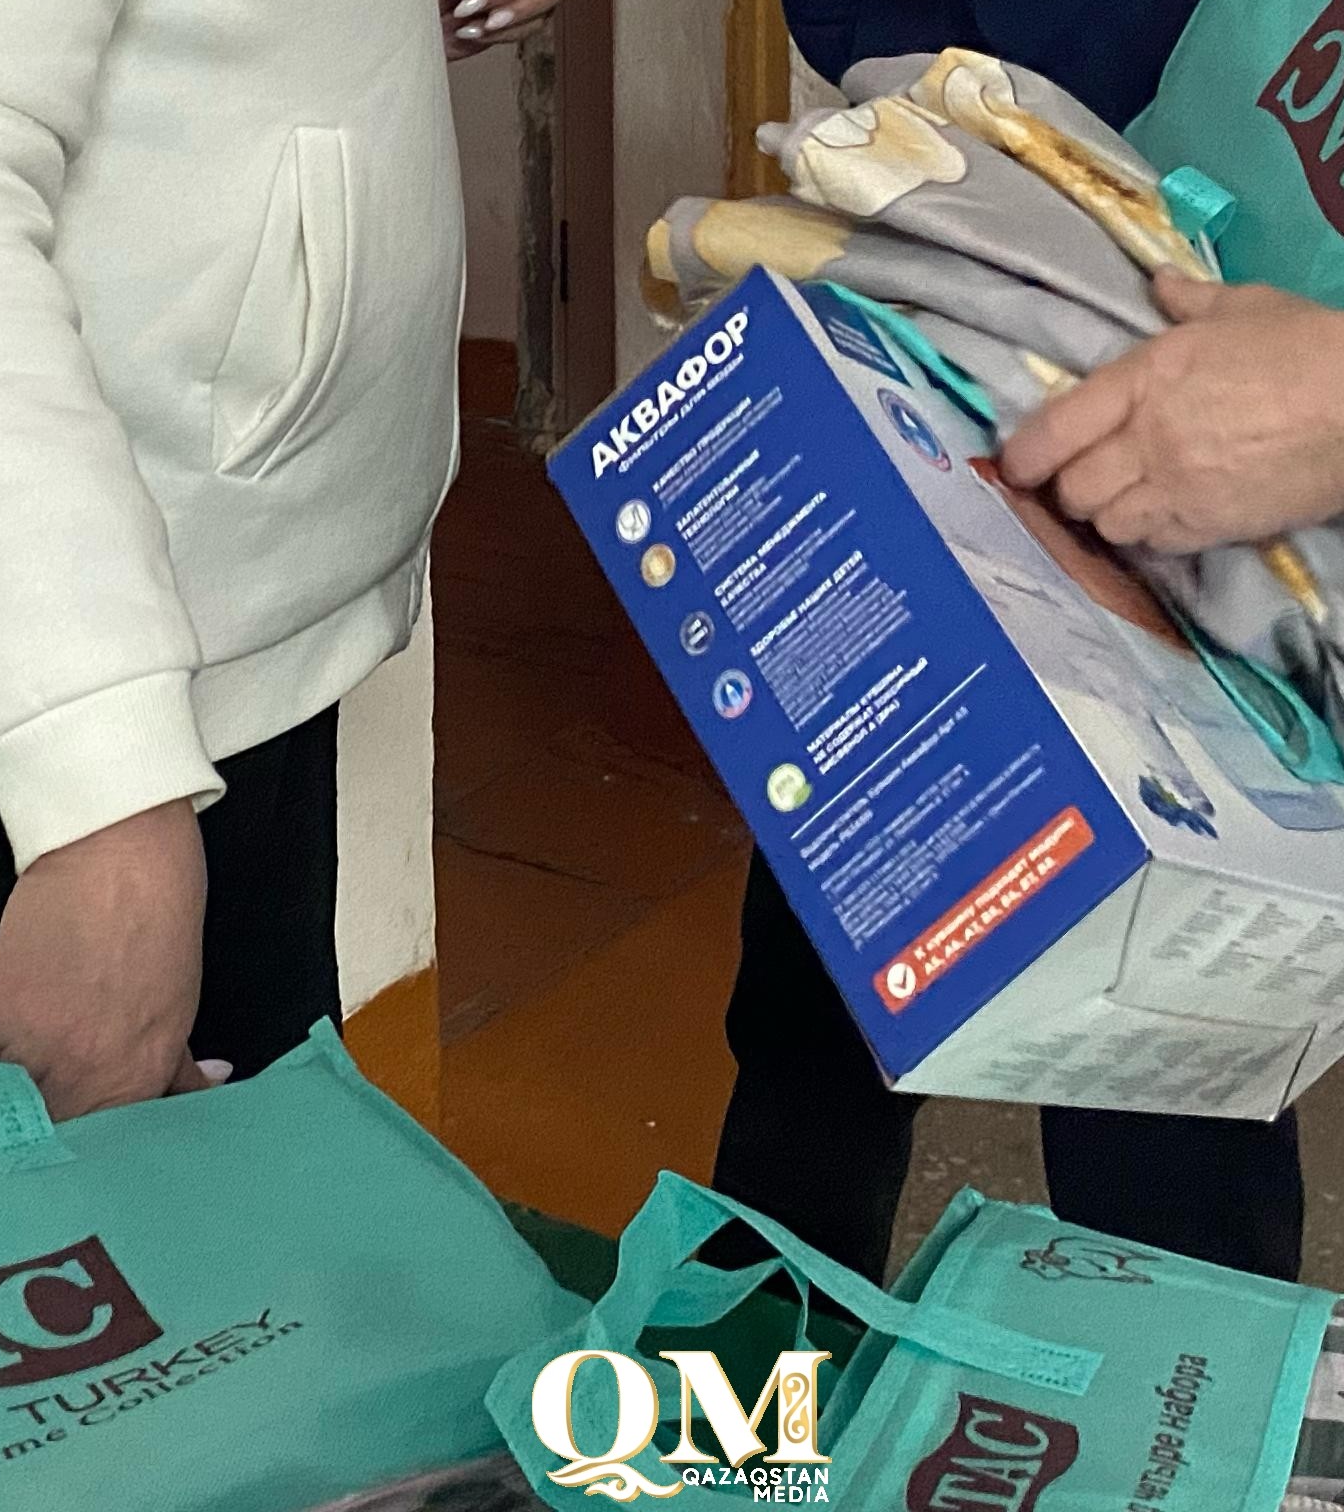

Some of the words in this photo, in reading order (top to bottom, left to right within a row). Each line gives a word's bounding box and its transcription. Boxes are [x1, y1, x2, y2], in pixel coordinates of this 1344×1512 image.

[592, 312, 748, 478] АКВАФОР
[7, 1308, 273, 1426] TURKEY
[80, 1320, 304, 1428] Collection
[1155, 1352, 1213, 1433] набора
[928, 1408, 1050, 1512] TAC
[1134, 1433, 1190, 1501] четыре
